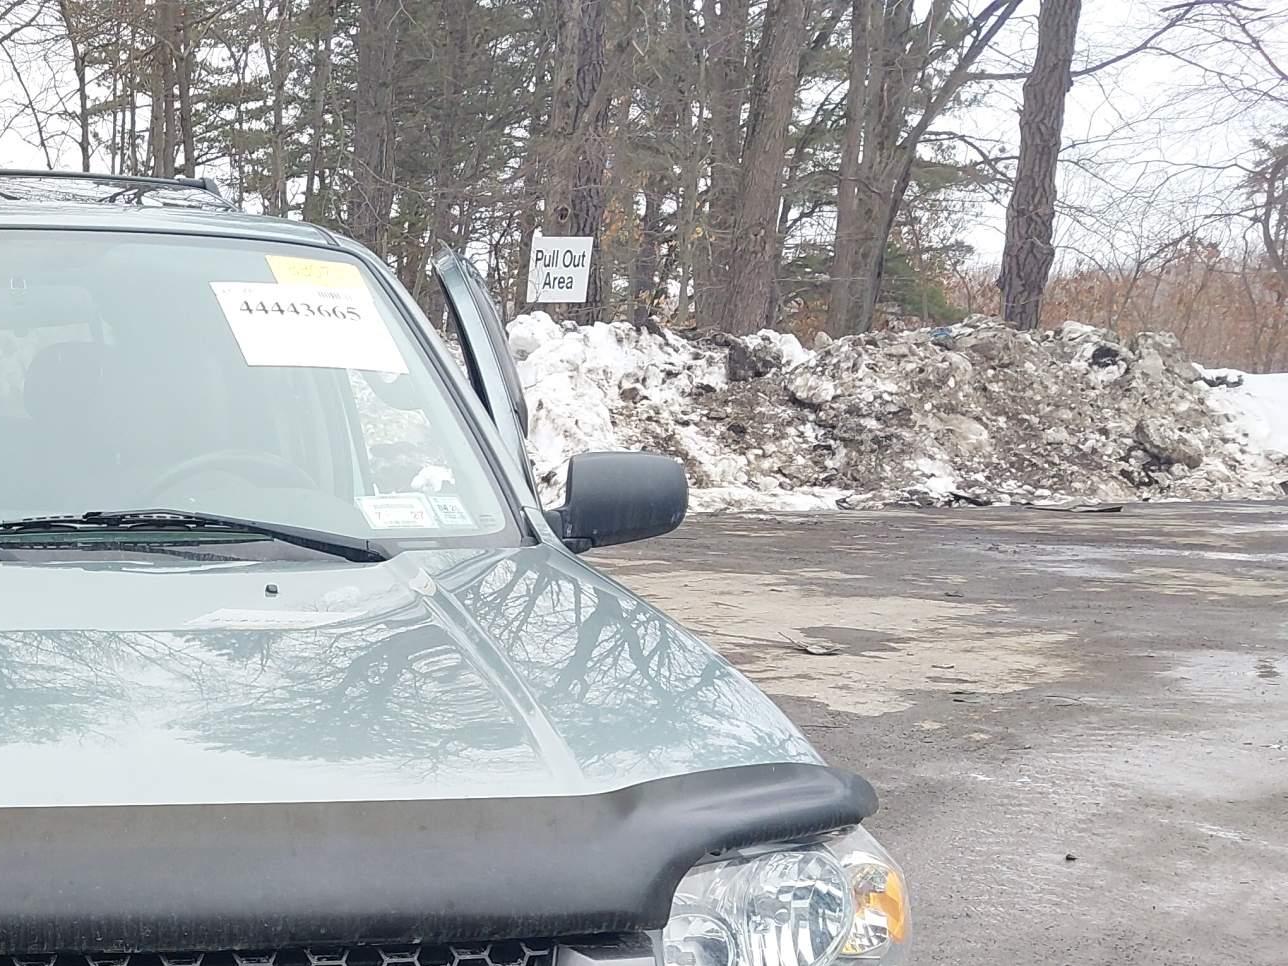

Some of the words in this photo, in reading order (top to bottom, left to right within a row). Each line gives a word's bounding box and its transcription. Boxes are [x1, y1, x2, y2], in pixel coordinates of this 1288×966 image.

[535, 250, 559, 268] Pull
[562, 250, 585, 268] Out
[542, 272, 573, 289] Area
[239, 300, 362, 321] 44443665
